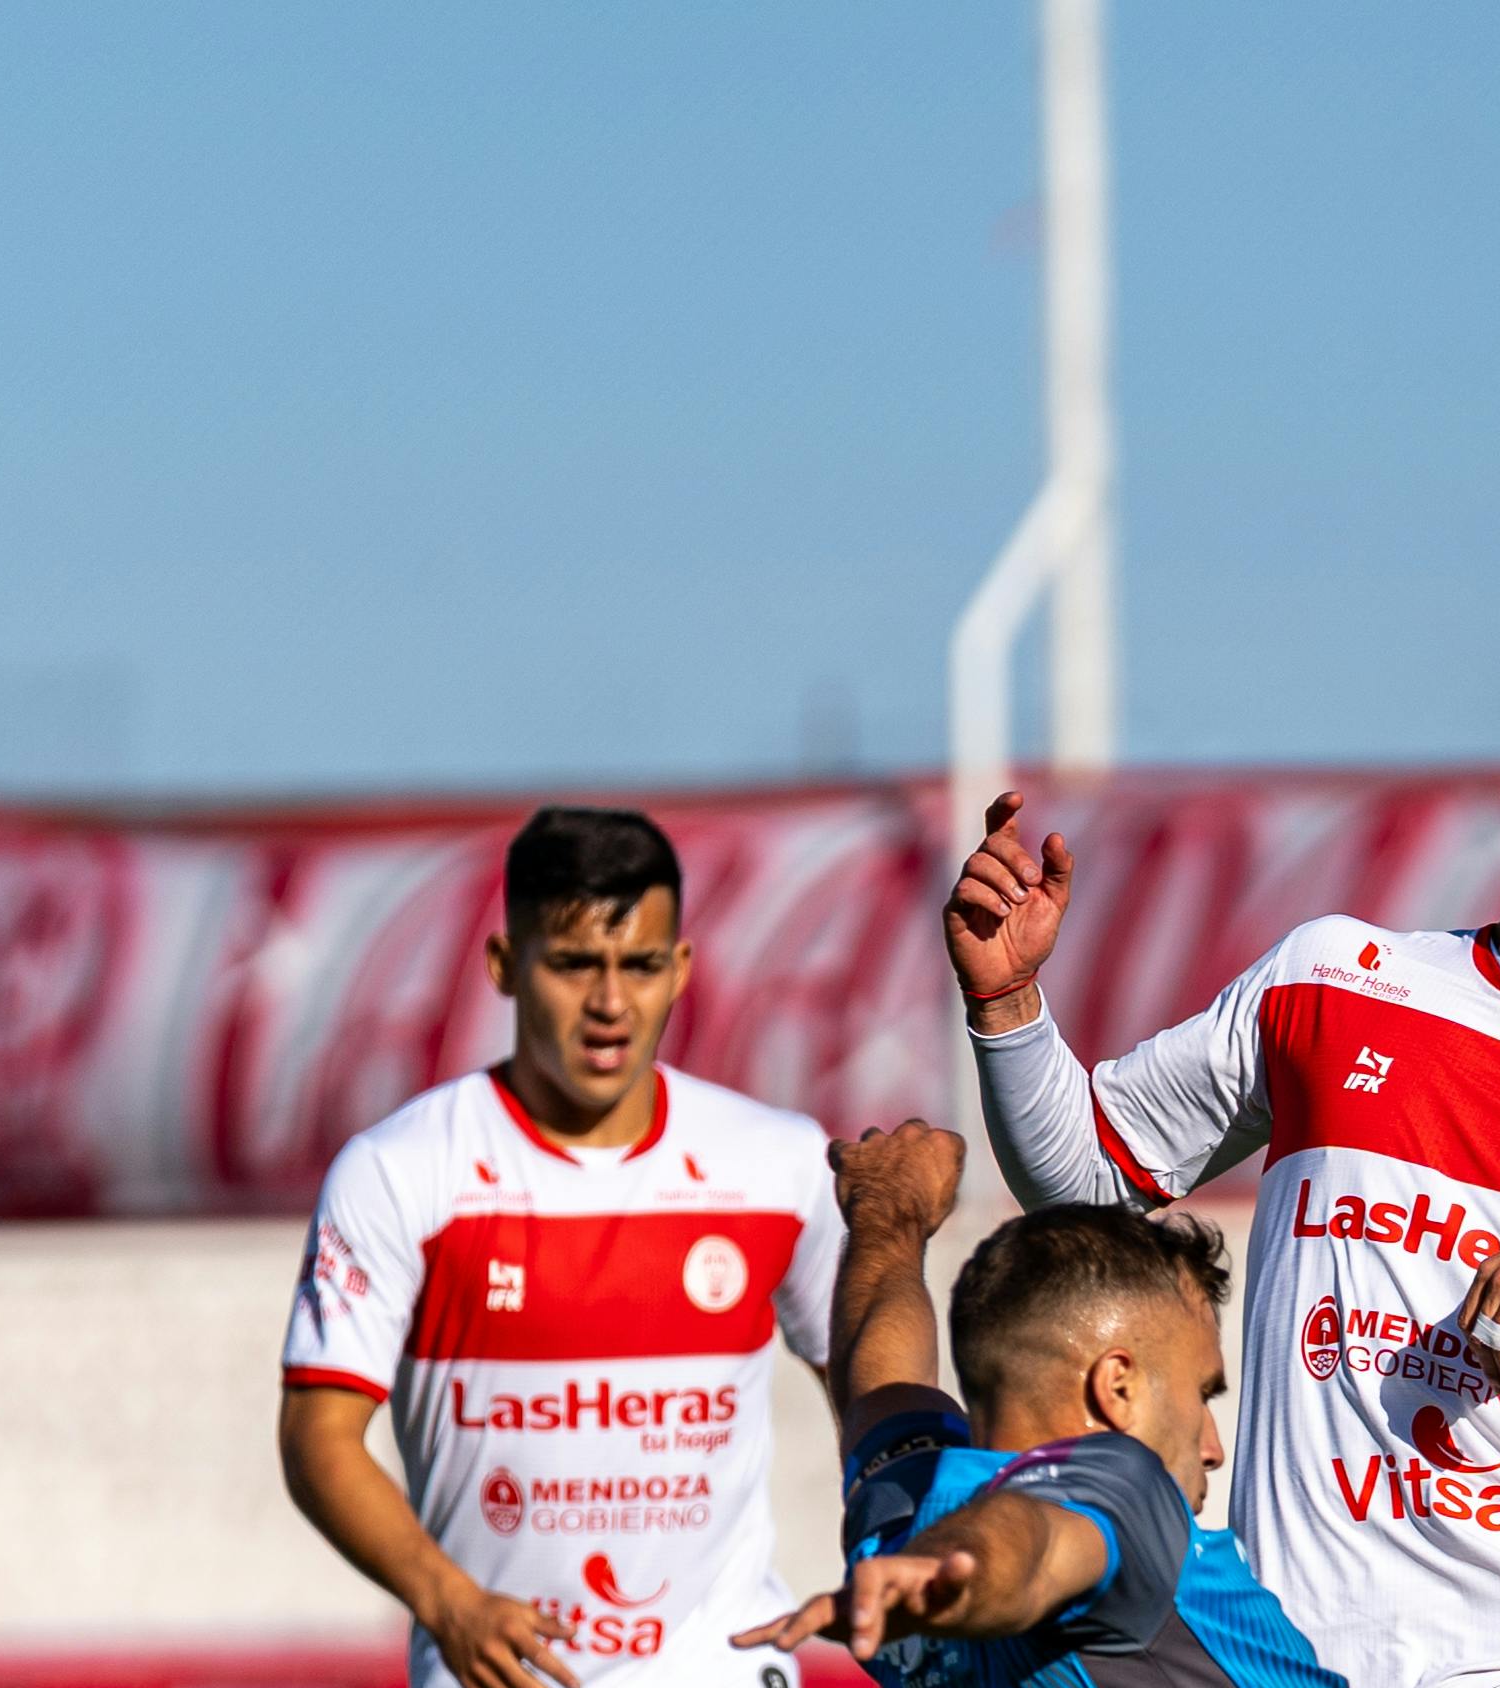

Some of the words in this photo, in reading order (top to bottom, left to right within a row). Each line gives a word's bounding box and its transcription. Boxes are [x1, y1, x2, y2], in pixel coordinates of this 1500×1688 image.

[1311, 963, 1361, 984] Hathor
[1361, 976, 1412, 999] Hotels
[1343, 1072, 1387, 1094] IFK
[451, 1378, 739, 1430] LasHeras
[675, 1429, 733, 1456] hogar
[531, 1473, 712, 1503] MENDOZA
[531, 1503, 710, 1535] GOBIERNO
[531, 1597, 665, 1658] tsa
